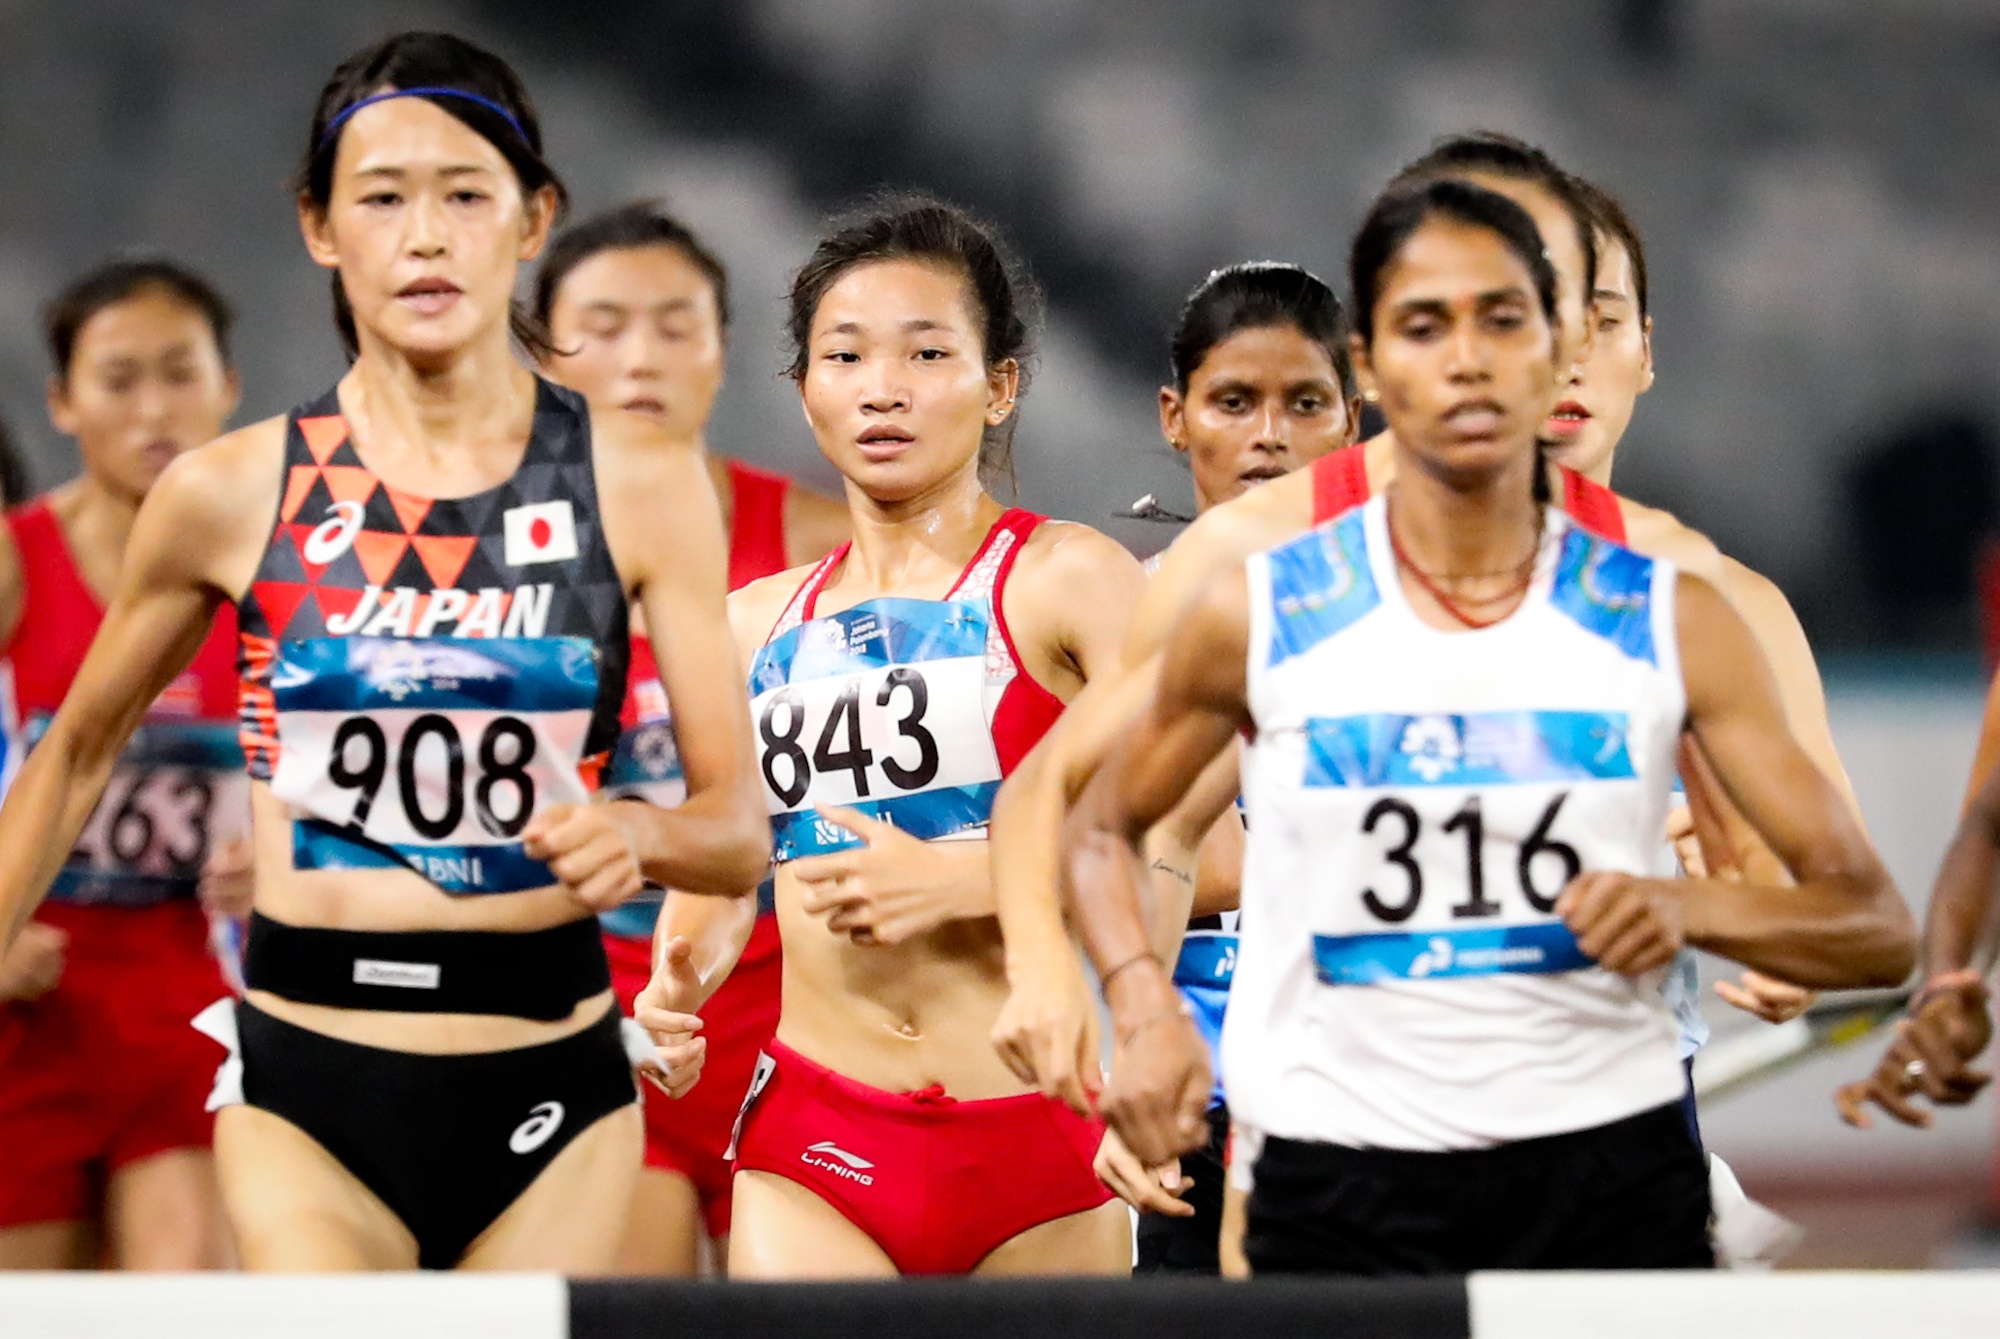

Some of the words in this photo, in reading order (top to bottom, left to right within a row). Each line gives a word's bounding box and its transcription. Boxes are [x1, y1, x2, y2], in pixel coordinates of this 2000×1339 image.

[327, 584, 554, 637] JAPAN
[329, 713, 538, 839] 908
[759, 668, 939, 808] 843
[71, 768, 212, 866] 63
[1361, 789, 1582, 923] 316
[428, 856, 483, 885] BNI
[800, 1152, 874, 1186] LI-NING
